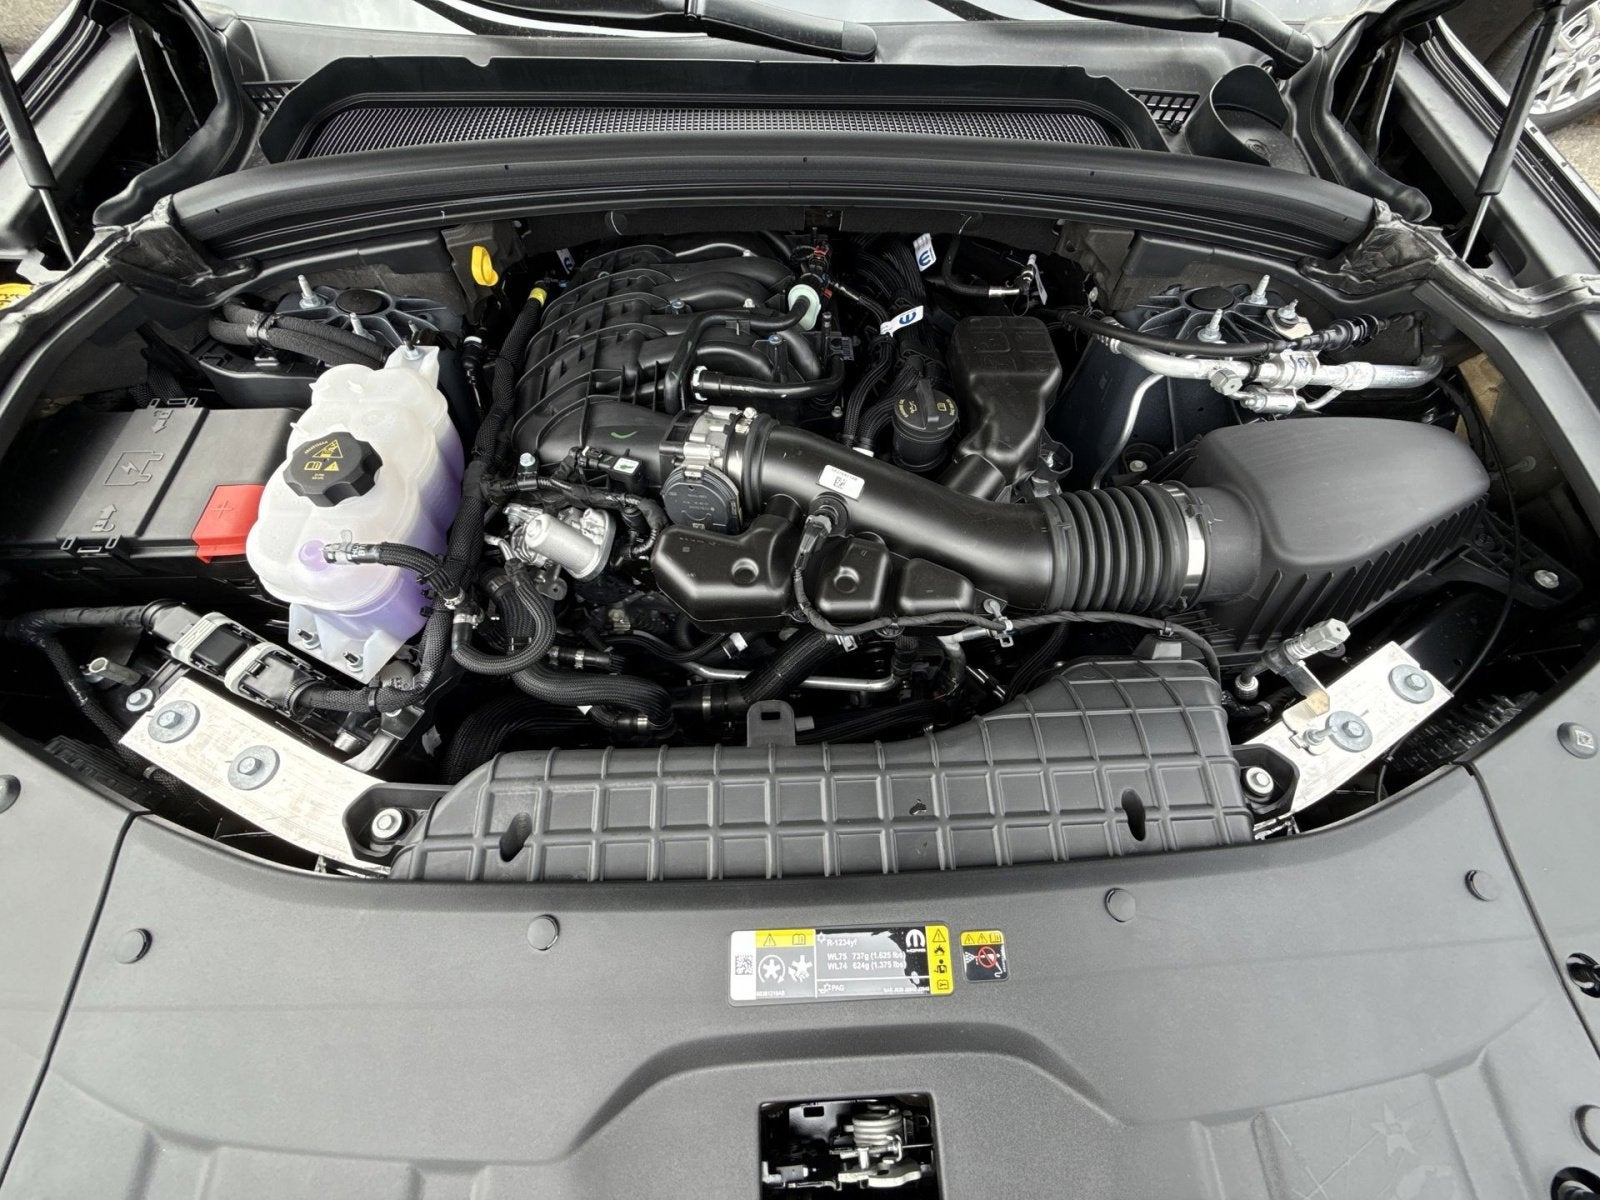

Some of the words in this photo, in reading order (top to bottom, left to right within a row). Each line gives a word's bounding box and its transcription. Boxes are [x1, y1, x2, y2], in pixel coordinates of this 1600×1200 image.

[827, 938, 858, 948] R-1234yf
[827, 952, 848, 961] WL75
[852, 952, 869, 962] 737g
[827, 961, 849, 970] WL74
[831, 984, 845, 992] PAG
